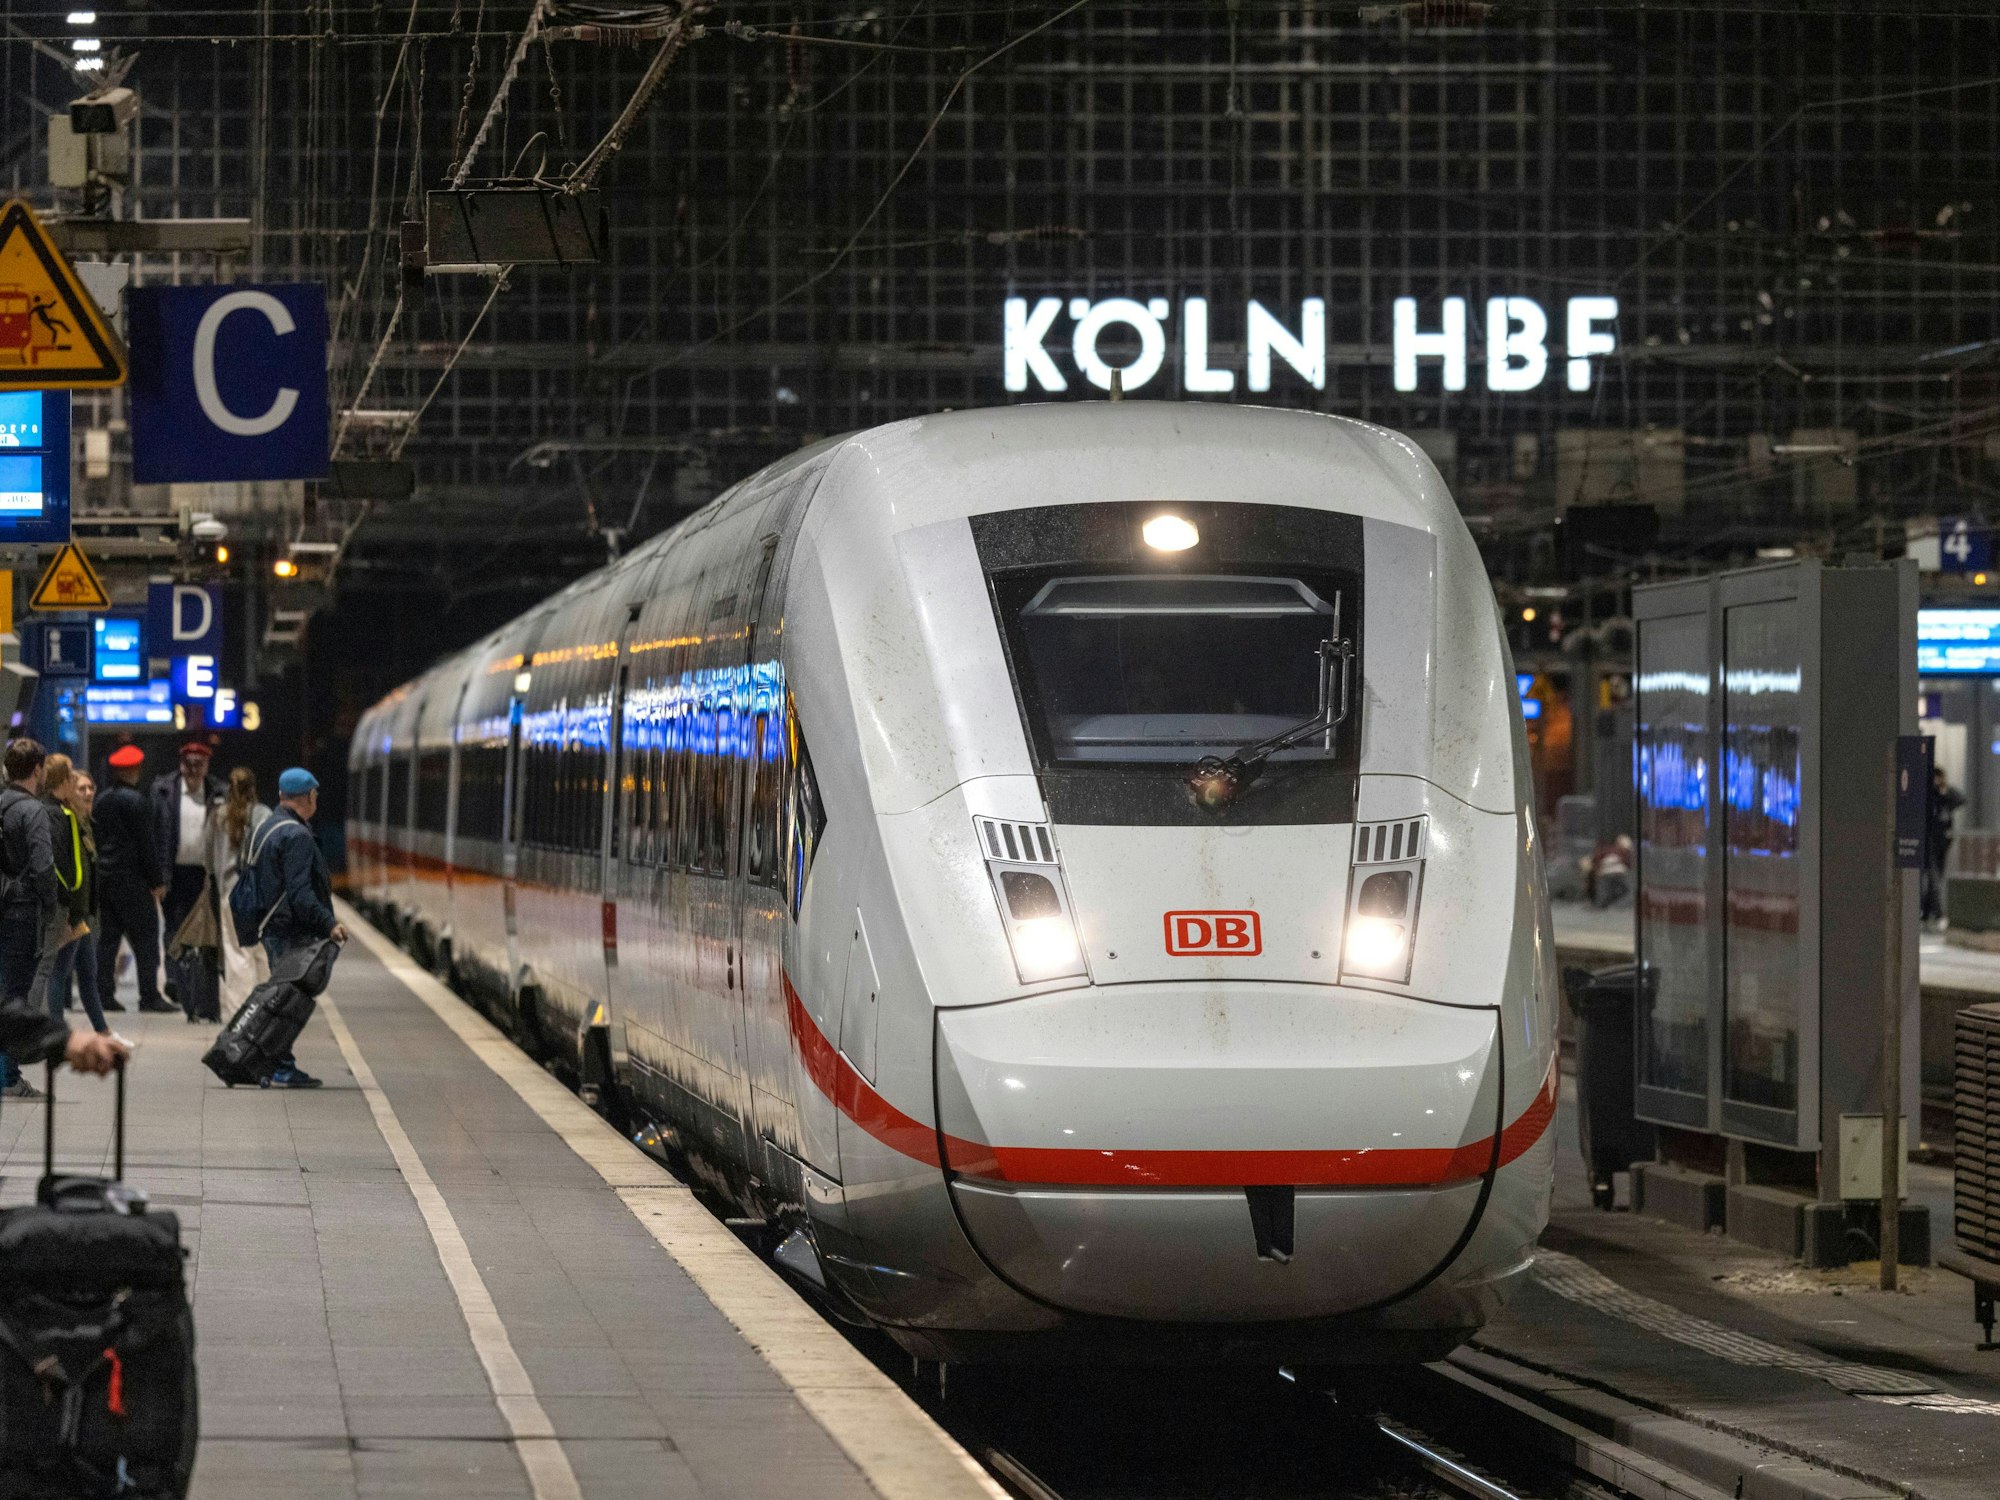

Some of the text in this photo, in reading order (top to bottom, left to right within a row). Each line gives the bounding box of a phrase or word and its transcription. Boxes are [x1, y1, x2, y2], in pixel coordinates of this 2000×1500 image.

[193, 290, 300, 437] C
[1004, 297, 1619, 393] KÖLN HBF
[1944, 520, 1972, 562] 4
[172, 585, 213, 641] D
[187, 655, 214, 698] E
[214, 688, 236, 723] F
[242, 702, 261, 731] 3
[1176, 917, 1250, 948] DB
